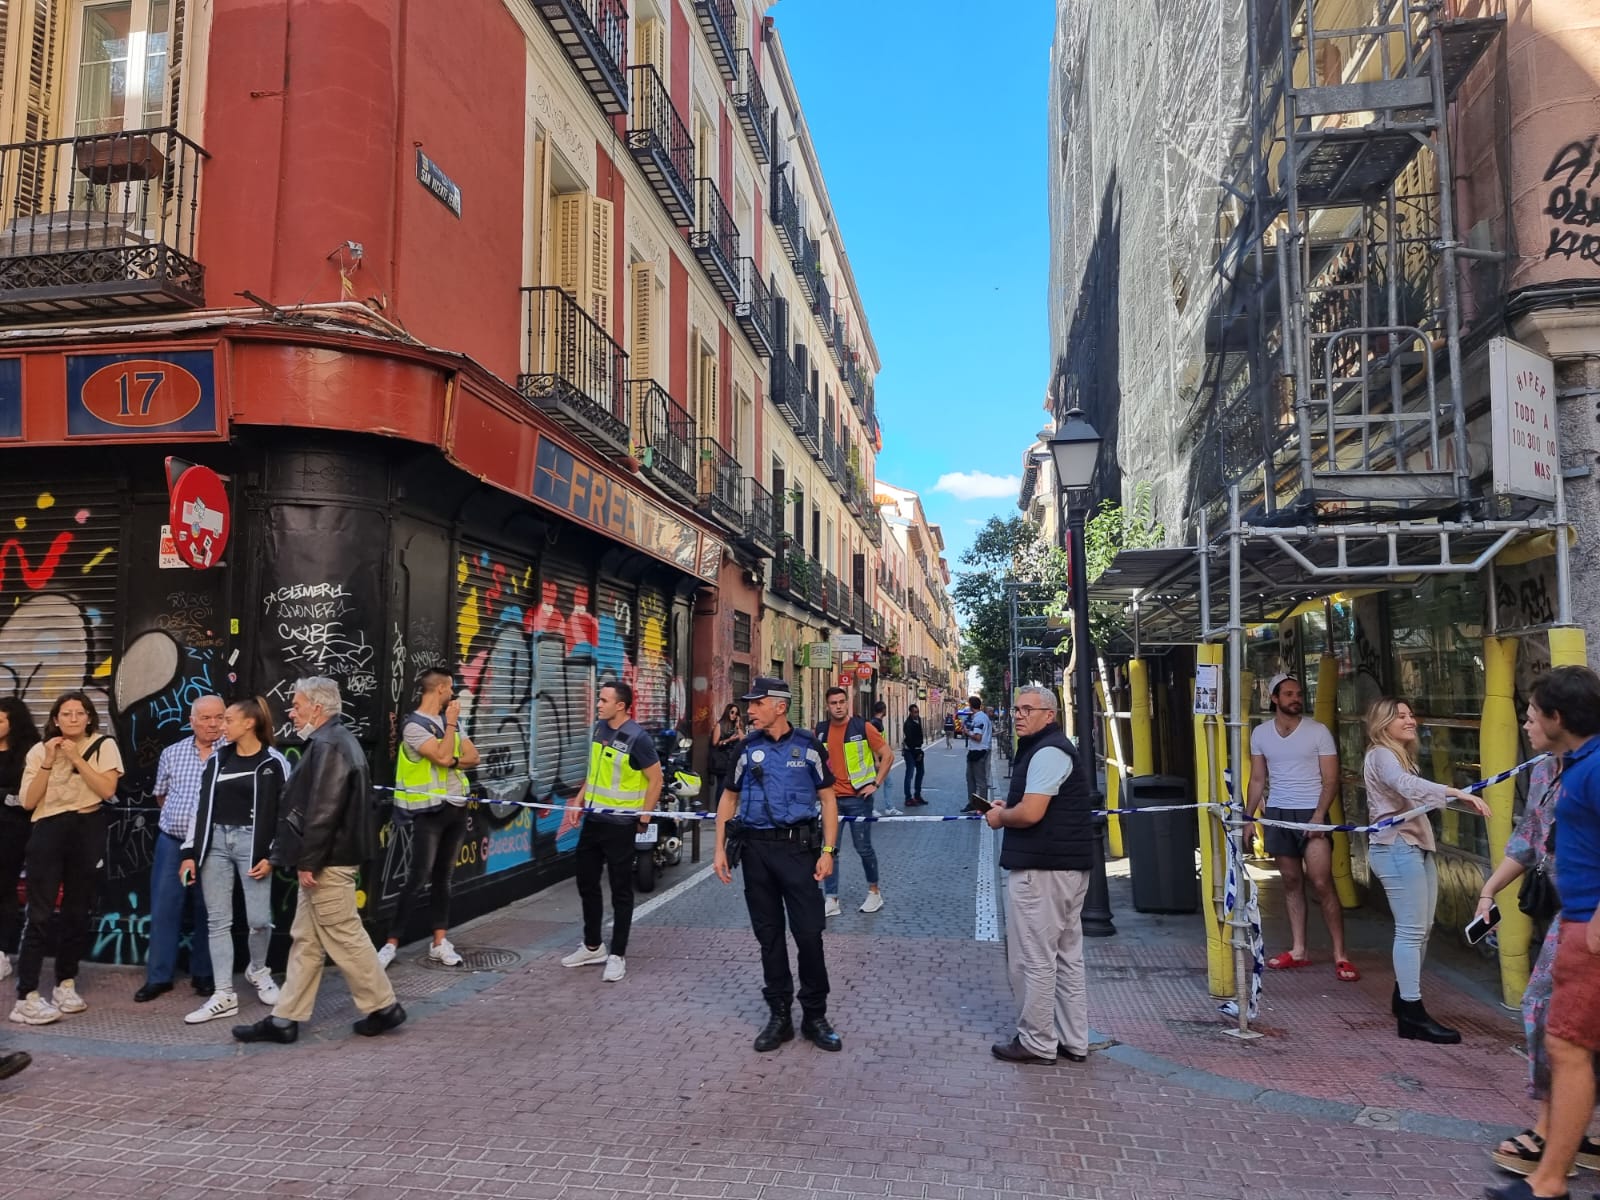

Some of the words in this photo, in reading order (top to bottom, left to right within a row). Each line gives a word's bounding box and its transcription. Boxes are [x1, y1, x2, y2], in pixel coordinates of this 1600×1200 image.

[115, 371, 165, 416] 17
[1517, 371, 1546, 400] HIPER
[1515, 401, 1535, 425] TODO
[1543, 413, 1549, 431] A
[1513, 428, 1526, 448] 100
[1527, 432, 1541, 453] 300
[1534, 461, 1551, 481] MAS
[857, 665, 871, 674] ria
